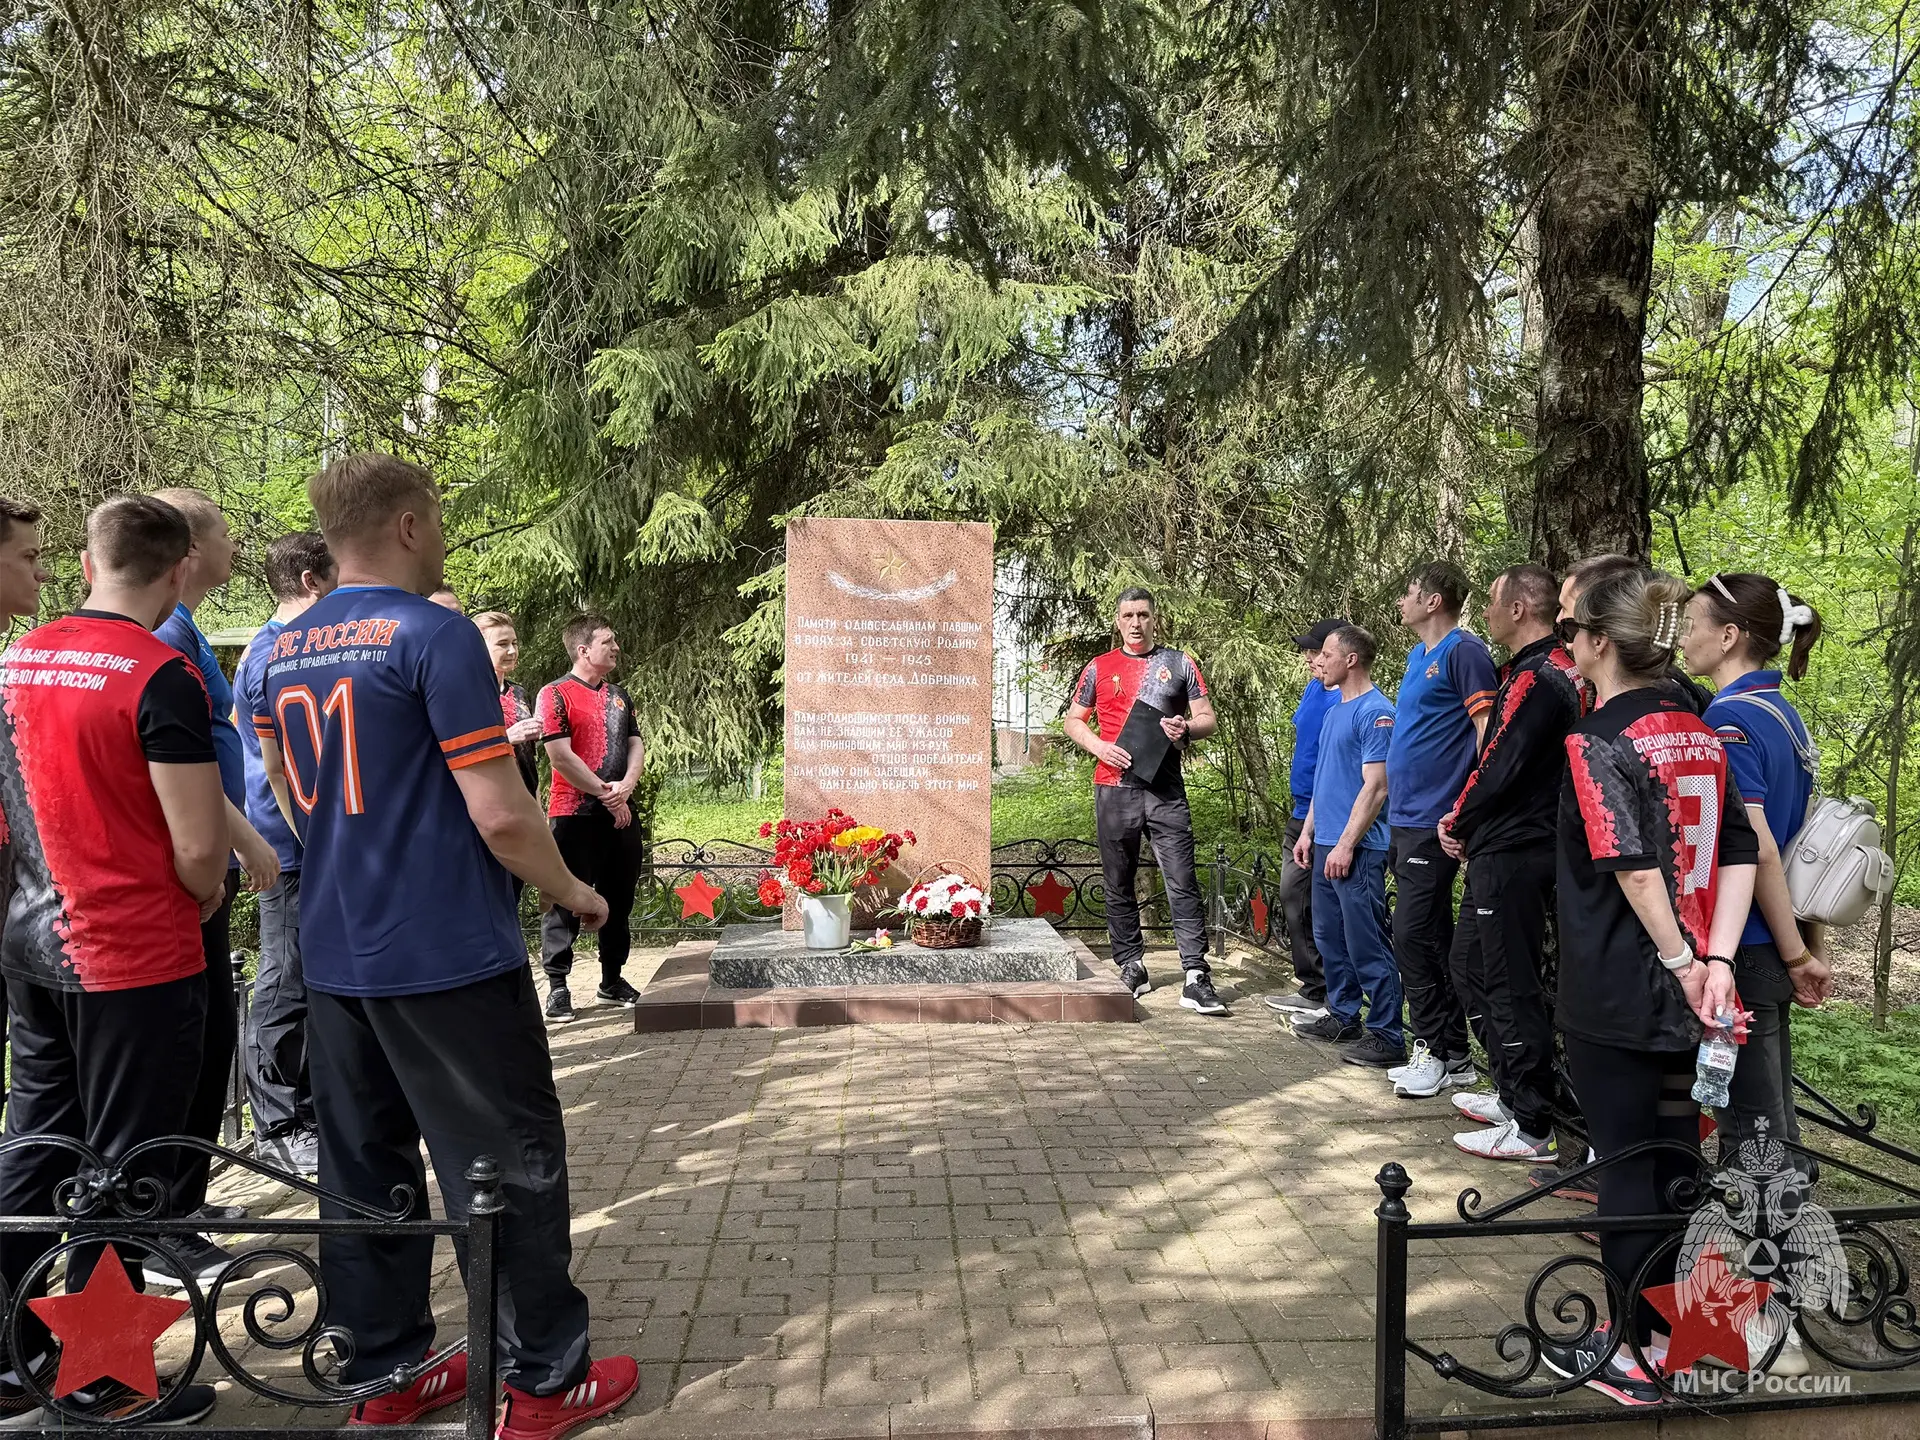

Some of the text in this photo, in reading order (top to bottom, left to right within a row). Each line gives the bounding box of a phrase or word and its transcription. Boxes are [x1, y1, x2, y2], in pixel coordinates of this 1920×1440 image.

[942, 621, 982, 632] ПАВШИМ
[302, 618, 400, 653] РОССИИ
[795, 636, 801, 645] В
[804, 636, 834, 646] БОЯХ
[840, 637, 852, 646] ЗА
[861, 636, 930, 648] СОВЕТСКУЮ
[50, 650, 139, 674] УПРАВЛЕНИЕ
[300, 652, 341, 670] УПРАВЛЕНИЕ
[342, 650, 359, 662] ФПС
[361, 650, 387, 662] №101
[845, 654, 874, 664] 1941
[902, 654, 932, 665] 1945
[32, 670, 56, 686] МЧС
[55, 672, 107, 691] РОССИИ
[798, 672, 811, 682] ОТ
[817, 670, 870, 684] ЖИТЕЛЕЙ
[876, 673, 904, 684] СЕЛА
[896, 714, 930, 724] ПОСЛЕ
[936, 712, 970, 725] ВОЙНЫ
[820, 727, 834, 736] НЕ
[838, 727, 885, 737] ЗНАВШИМ
[908, 728, 953, 738] УЖАСОВ
[276, 677, 364, 816] 01
[886, 741, 907, 751] МИР
[912, 742, 924, 751] ИЗ
[928, 742, 950, 751] РУК
[872, 752, 982, 764] ОТЦОВ ПОБЕДИТЕЛЕЙ
[818, 766, 846, 776] КОМУ
[850, 767, 869, 776] ОНИ
[882, 780, 920, 790] БЕРЕЧЬ
[926, 780, 954, 790] ЭТОТ
[958, 780, 979, 790] МИР
